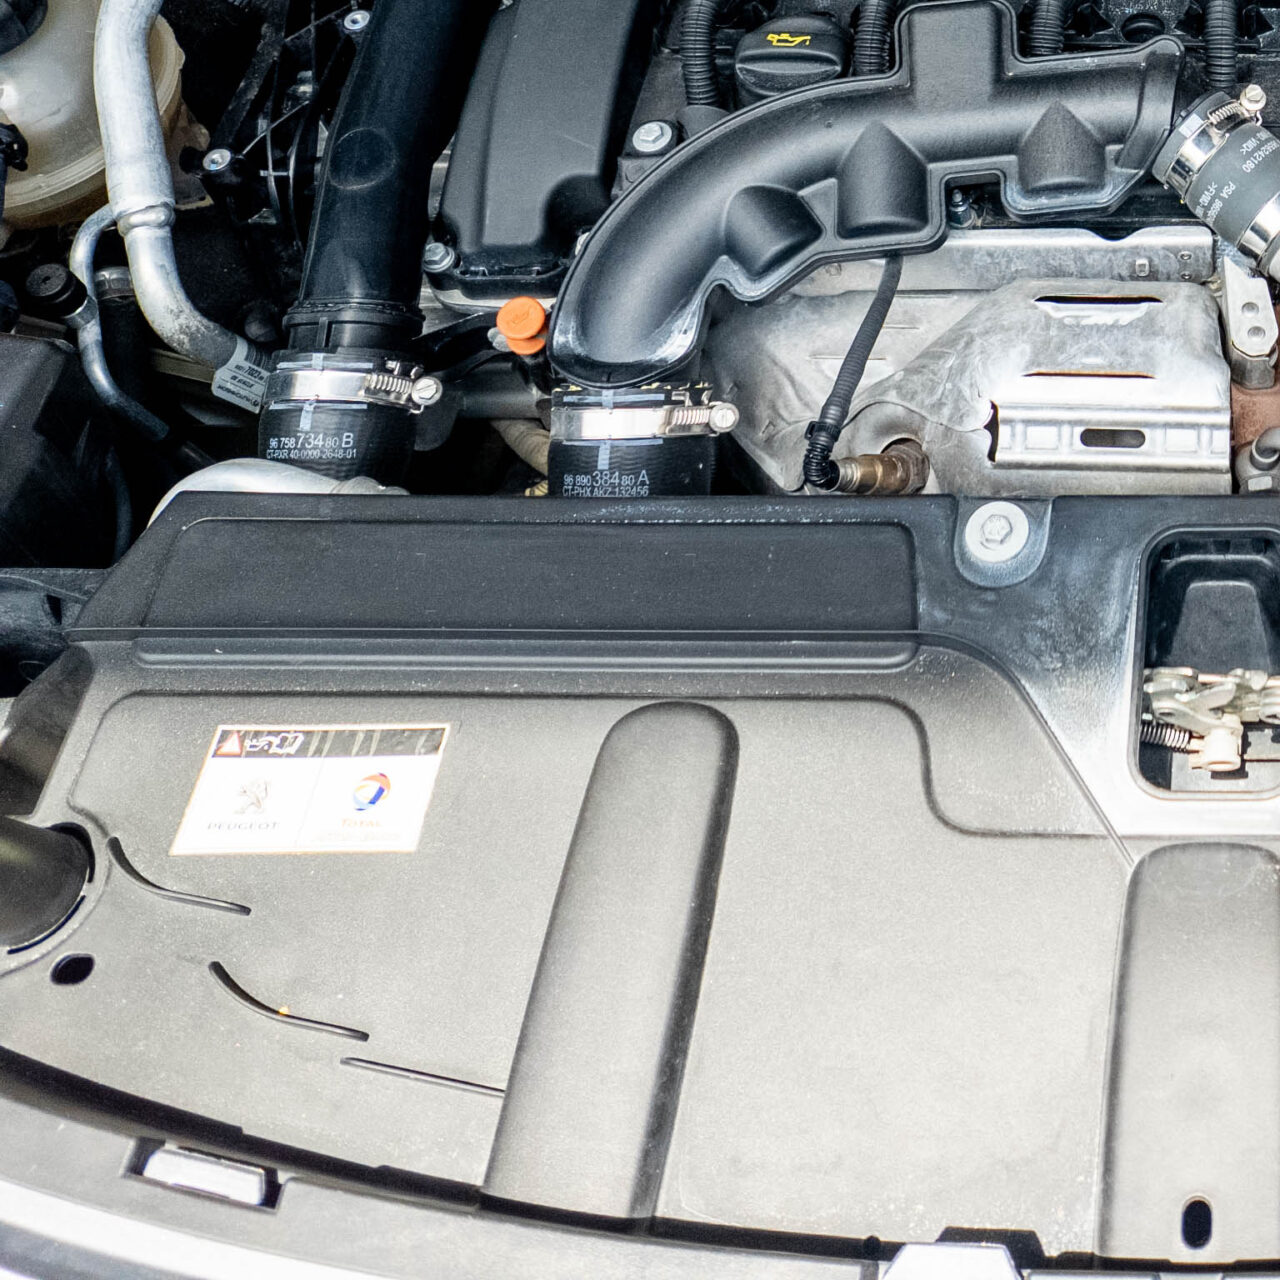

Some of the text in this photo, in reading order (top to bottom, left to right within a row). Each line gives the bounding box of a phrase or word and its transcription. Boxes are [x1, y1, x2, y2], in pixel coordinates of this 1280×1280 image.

[1219, 181, 1236, 199] PSA
[280, 437, 296, 449] 758
[297, 432, 324, 448] 734
[325, 436, 339, 448] 80
[341, 432, 354, 448] B
[563, 470, 650, 486] 96 890 384 80 A
[207, 822, 280, 831] PEUGEOT
[340, 818, 382, 828] TOTAL
